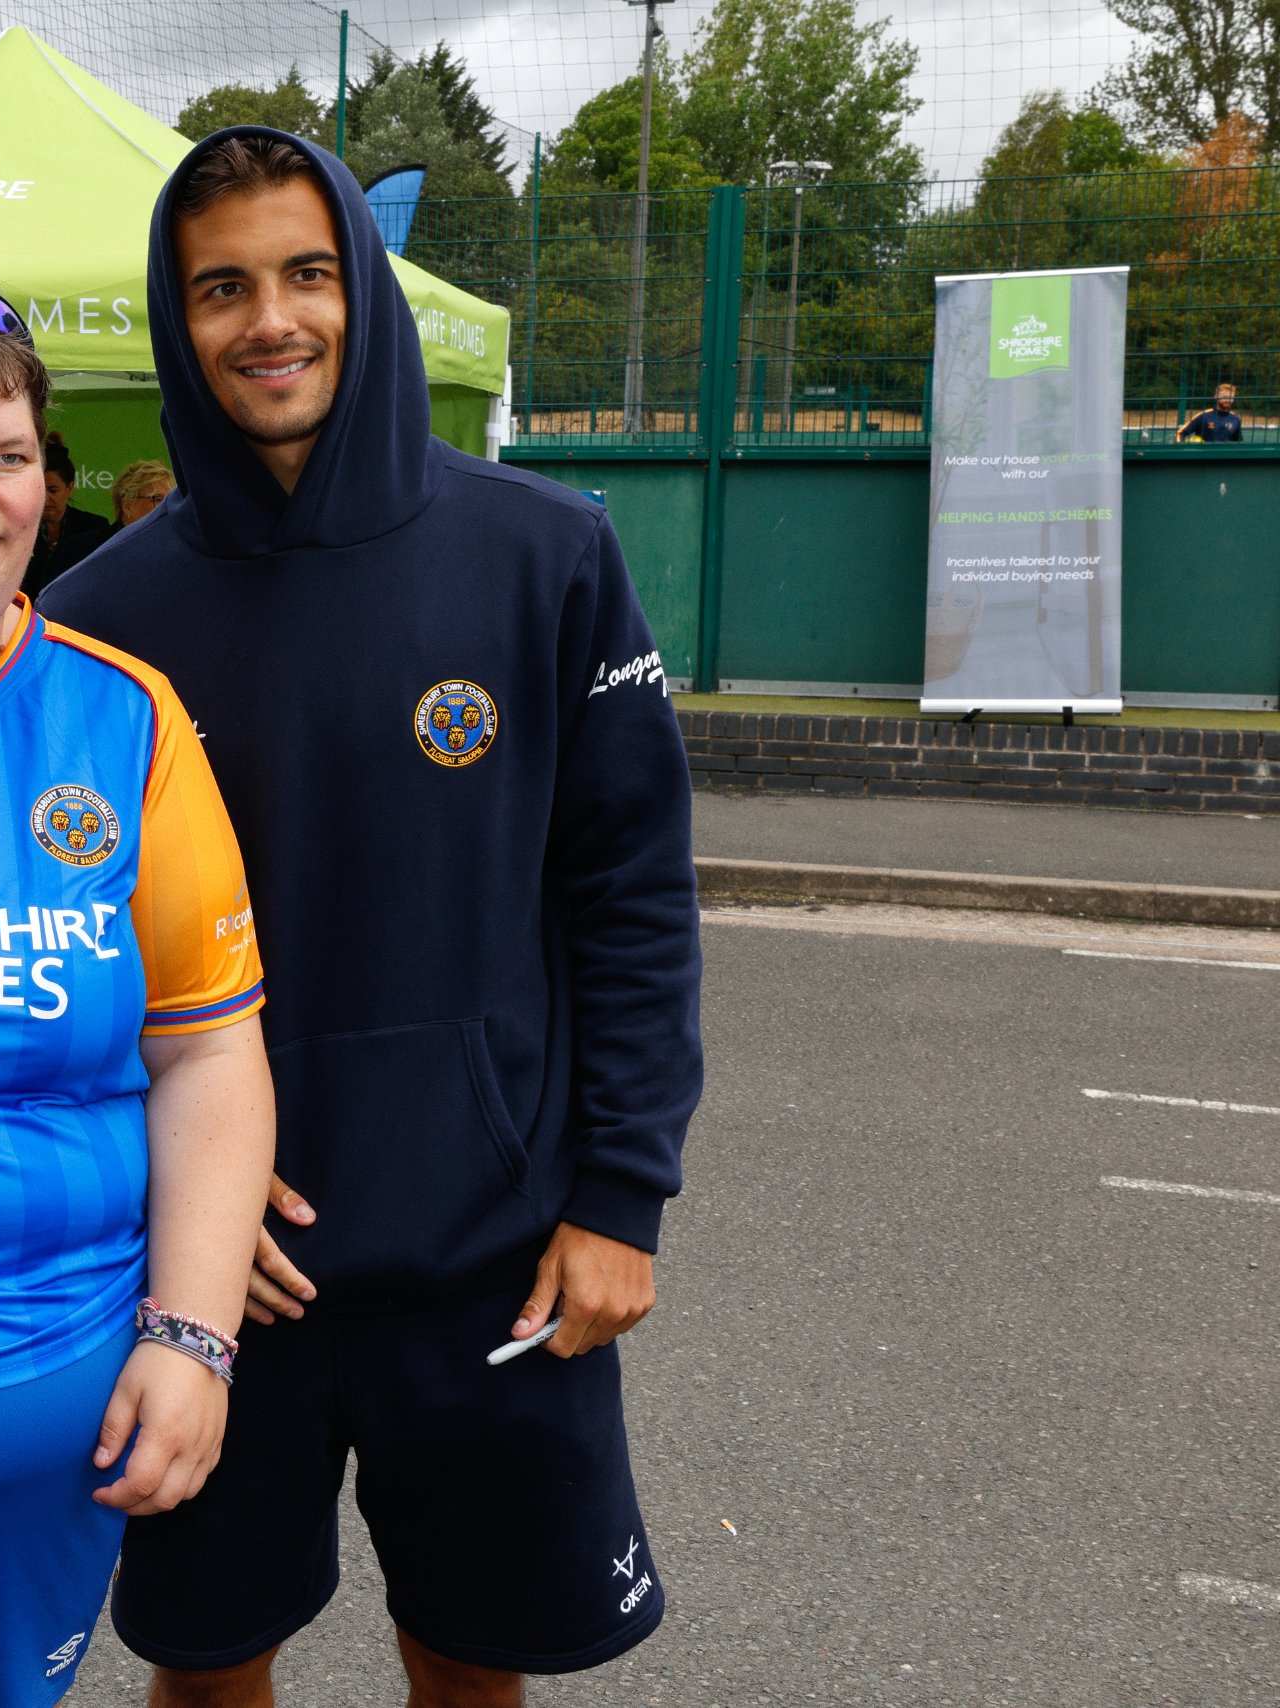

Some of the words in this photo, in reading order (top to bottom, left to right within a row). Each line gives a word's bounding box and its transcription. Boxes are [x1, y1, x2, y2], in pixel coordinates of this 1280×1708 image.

[27, 297, 133, 335] MES
[449, 315, 485, 357] HOMES
[998, 336, 1063, 350] SHROPSHIRE
[1009, 346, 1050, 358] HOMES
[944, 455, 978, 466] Make
[981, 457, 1001, 465] our
[1003, 454, 1040, 465] house
[1001, 469, 1026, 479] with
[1029, 469, 1050, 479] our
[938, 512, 994, 523] HELPING
[997, 511, 1045, 522] HANDS
[1049, 509, 1113, 521] SCHEMES
[946, 556, 1007, 567] Incentives
[1009, 555, 1055, 567] tailored
[1058, 556, 1071, 566] to
[1073, 555, 1102, 567] your
[952, 571, 1009, 582] individual
[1012, 570, 1052, 582] buying
[1055, 569, 1095, 580] needs
[417, 687, 441, 735] SHREWSBURY
[441, 683, 464, 693] TOWN
[465, 685, 494, 715] FOOTBALL
[428, 747, 456, 764] FLOREAT
[457, 746, 484, 764] SALOPIA
[34, 790, 59, 833] SHREWSBURY
[58, 787, 82, 796] TOWN
[82, 790, 113, 821] FOOTBALL
[108, 821, 118, 840] CLUB
[48, 845, 79, 863] FLOREAT
[80, 849, 108, 865] SALOPIA
